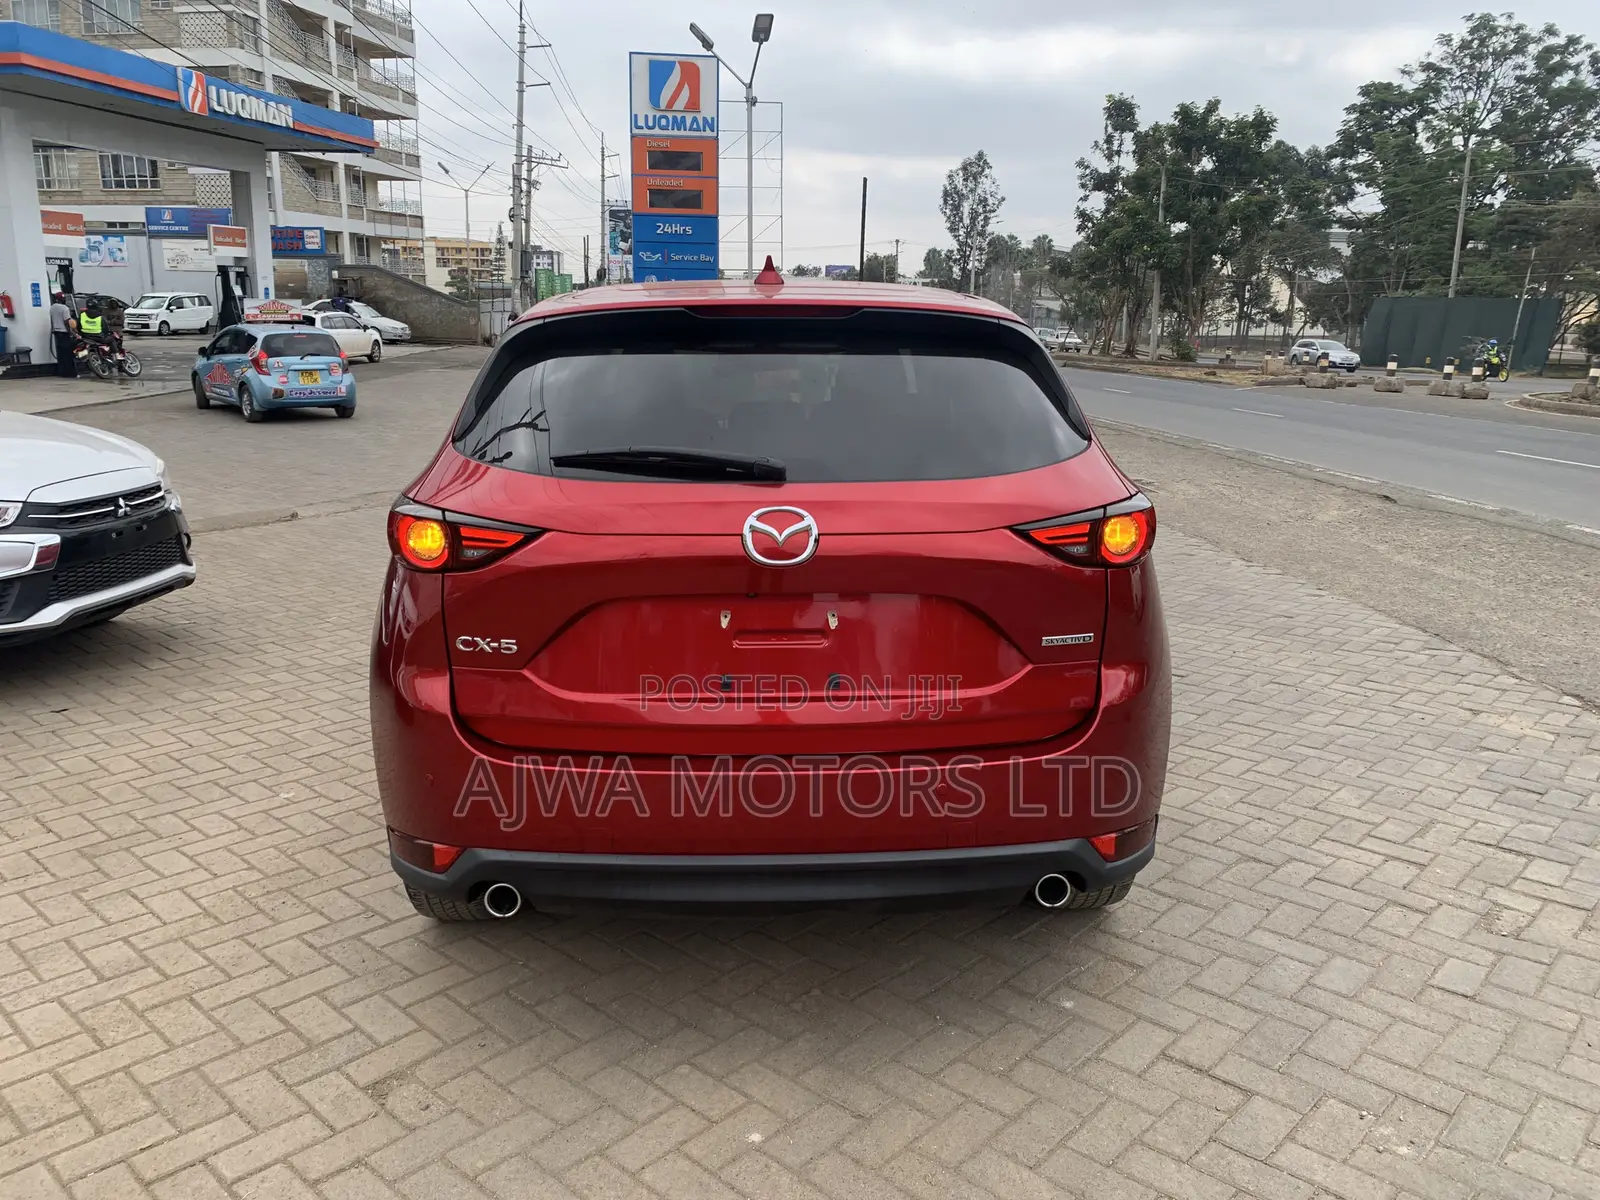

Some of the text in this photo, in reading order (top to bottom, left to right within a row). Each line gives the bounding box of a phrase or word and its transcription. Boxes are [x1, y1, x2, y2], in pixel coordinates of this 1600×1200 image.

[207, 85, 294, 129] LUQMAN
[633, 113, 715, 132] LUQMAN
[646, 139, 671, 148] Diesel
[647, 178, 684, 187] Unleaded
[656, 222, 692, 235] 24Hrs
[670, 253, 715, 263] Service Bay
[455, 635, 518, 654] CX-5
